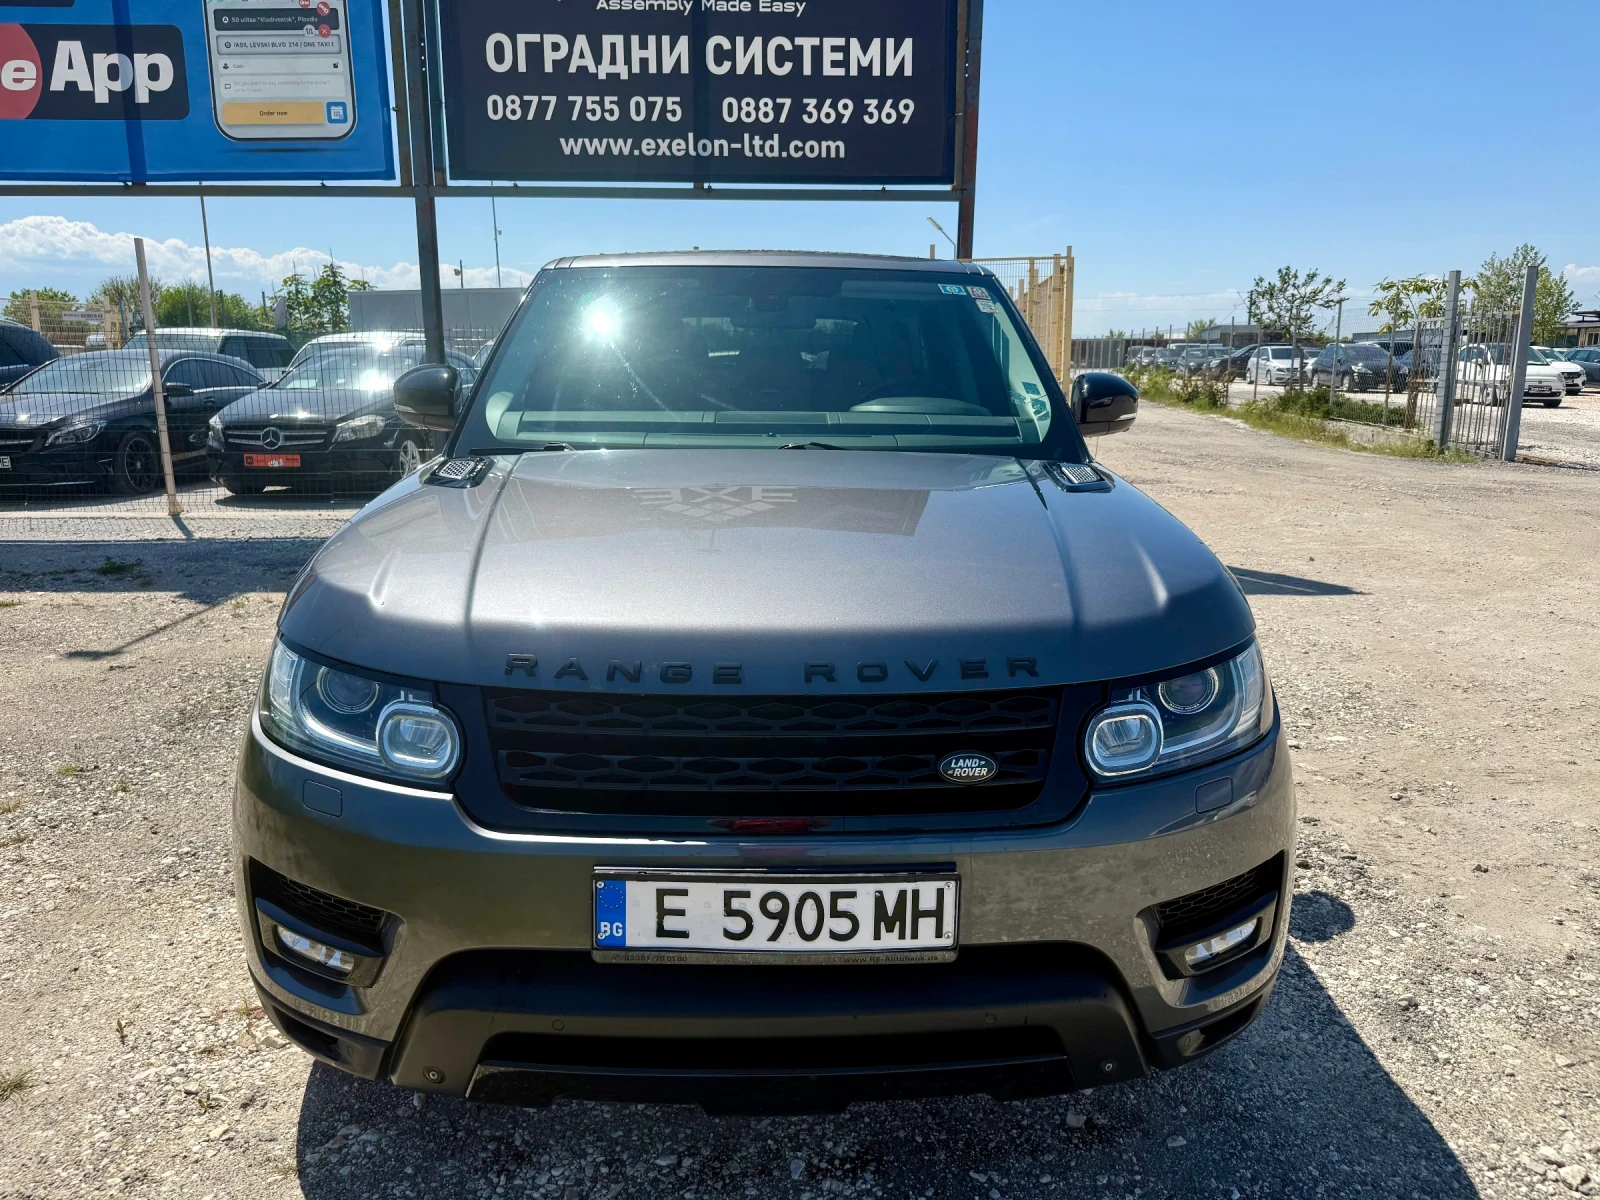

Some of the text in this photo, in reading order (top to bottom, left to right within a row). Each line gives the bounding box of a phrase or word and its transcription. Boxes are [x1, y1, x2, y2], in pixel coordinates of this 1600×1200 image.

[595, 0, 807, 18] Assembly Made Easy
[485, 32, 913, 80] ОГРАДНИ СИСТЕМИ
[49, 40, 174, 104] App
[486, 94, 915, 125] 0877 755 075 0887 369 369
[559, 132, 845, 159] www.exelon-ltd.com
[503, 652, 1040, 685] RANGE ROVER
[950, 758, 980, 768] LAND
[953, 767, 988, 777] ROVER
[599, 921, 623, 938] BG
[655, 888, 690, 939] E
[723, 890, 860, 942] 5905
